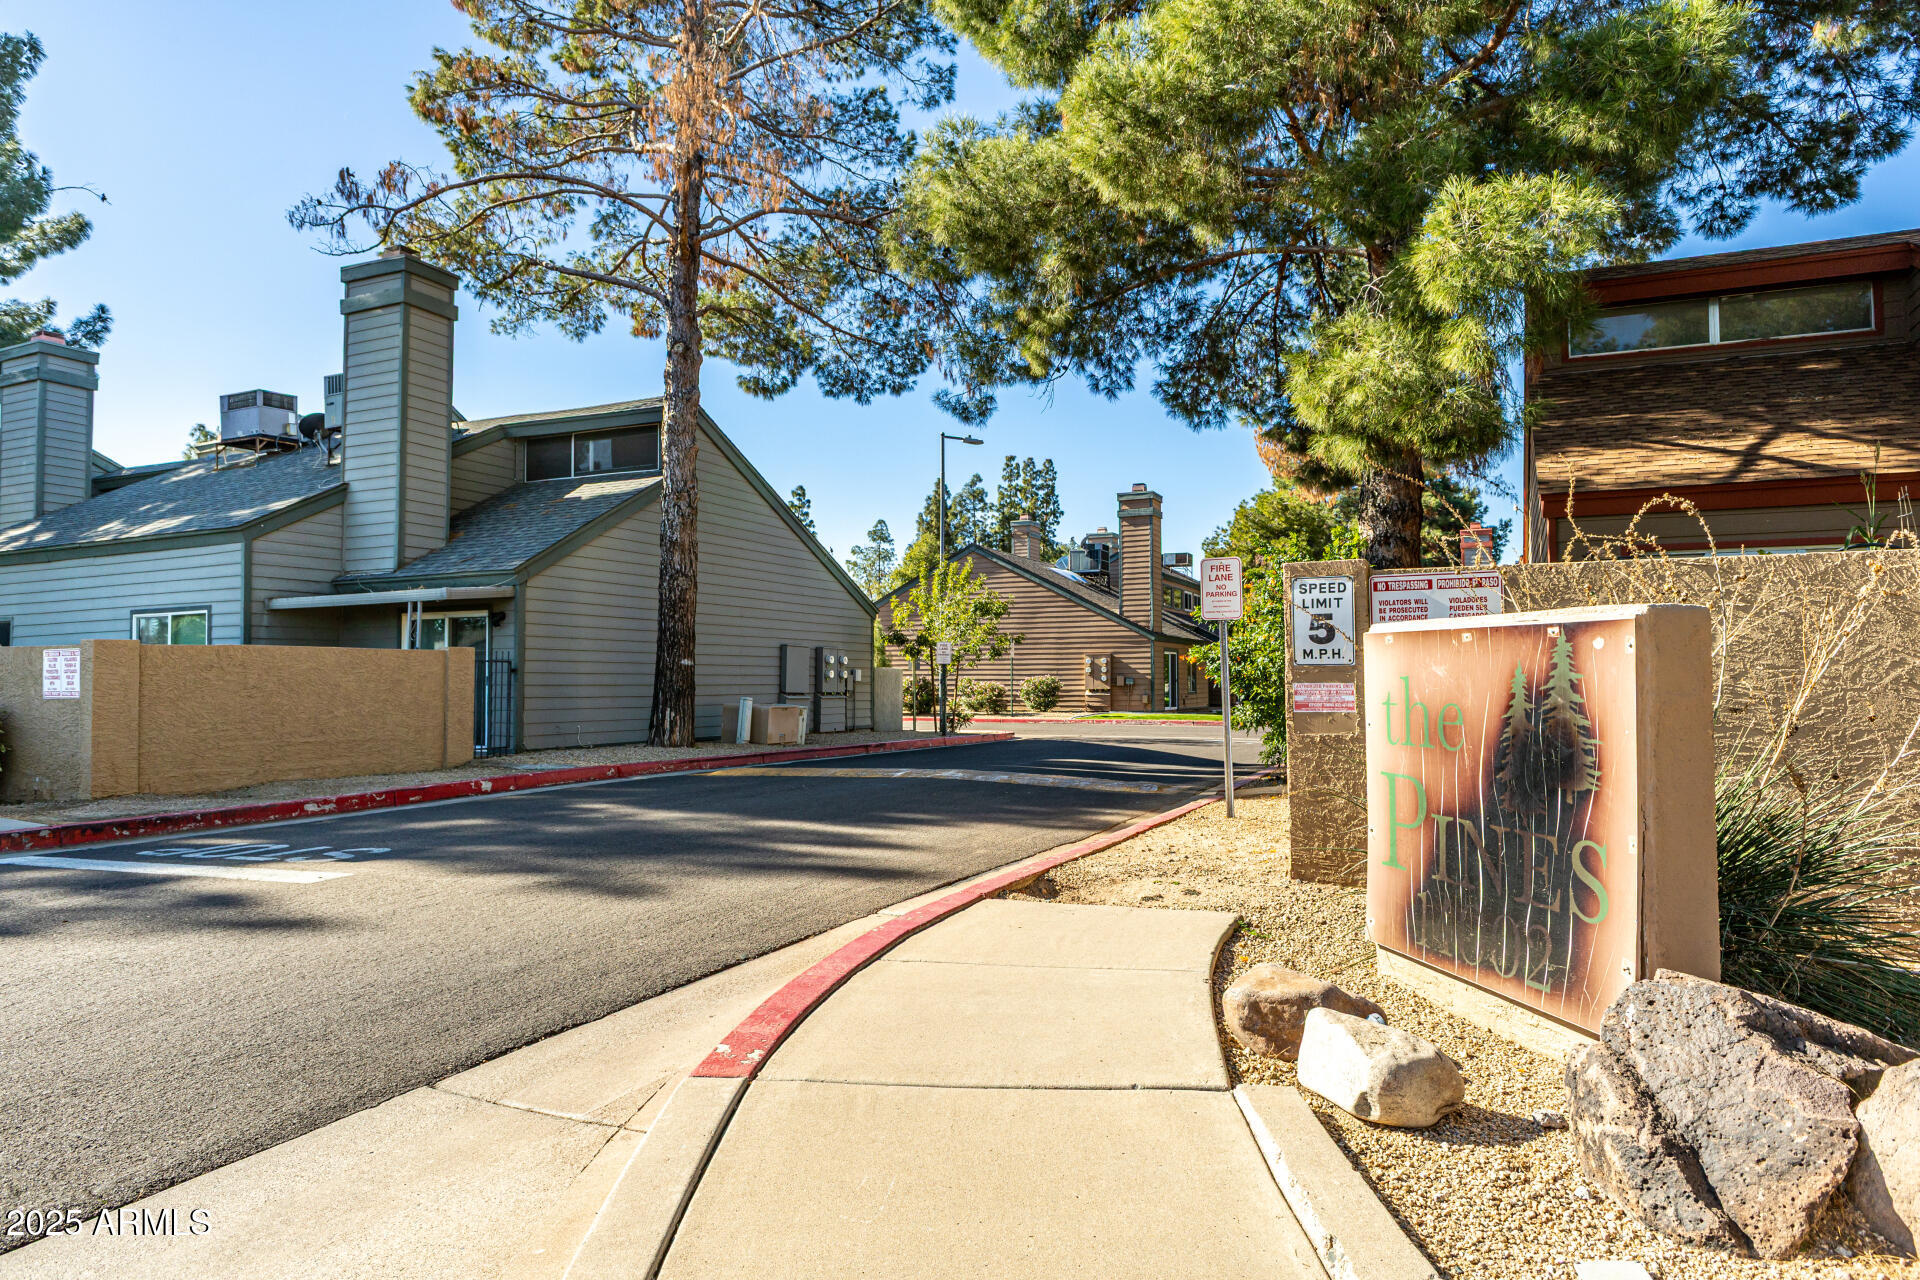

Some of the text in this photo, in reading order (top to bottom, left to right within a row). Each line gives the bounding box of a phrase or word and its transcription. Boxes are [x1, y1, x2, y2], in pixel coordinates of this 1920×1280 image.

[1210, 564, 1231, 572] FIRE
[1299, 582, 1347, 594] SPEED
[1377, 581, 1428, 591] NO TRESPASSING
[1437, 578, 1469, 589] PROHIBIDO
[1205, 590, 1238, 598] PARKING
[1302, 597, 1343, 609] LIMIT
[1449, 604, 1474, 612] PUEDEN
[1308, 613, 1336, 645] 5
[1302, 649, 1345, 660] M.P.H.
[1381, 676, 1465, 752] the
[1380, 771, 1609, 924] PINES
